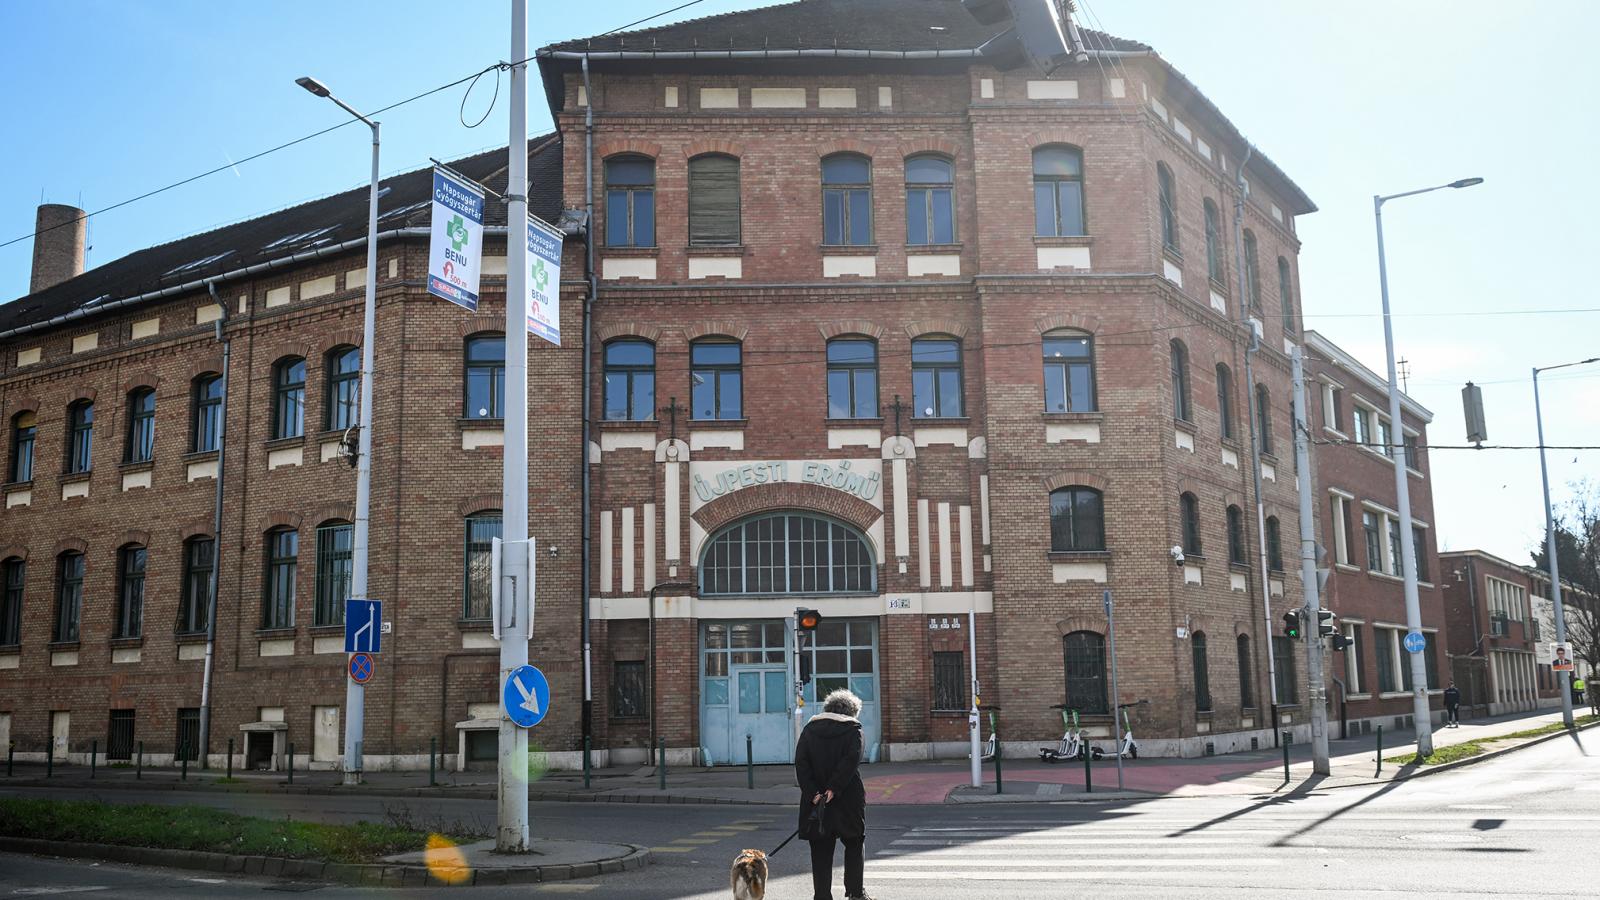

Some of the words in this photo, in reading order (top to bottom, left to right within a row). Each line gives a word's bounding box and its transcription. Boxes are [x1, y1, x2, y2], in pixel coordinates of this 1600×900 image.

[436, 189, 481, 220] Gyógyszertár
[443, 182, 476, 206] Napsugár
[445, 248, 467, 267] BENU
[532, 289, 549, 305] BENU
[694, 461, 788, 502] ÚJPESTI
[802, 459, 880, 500] ERŐMŰ
